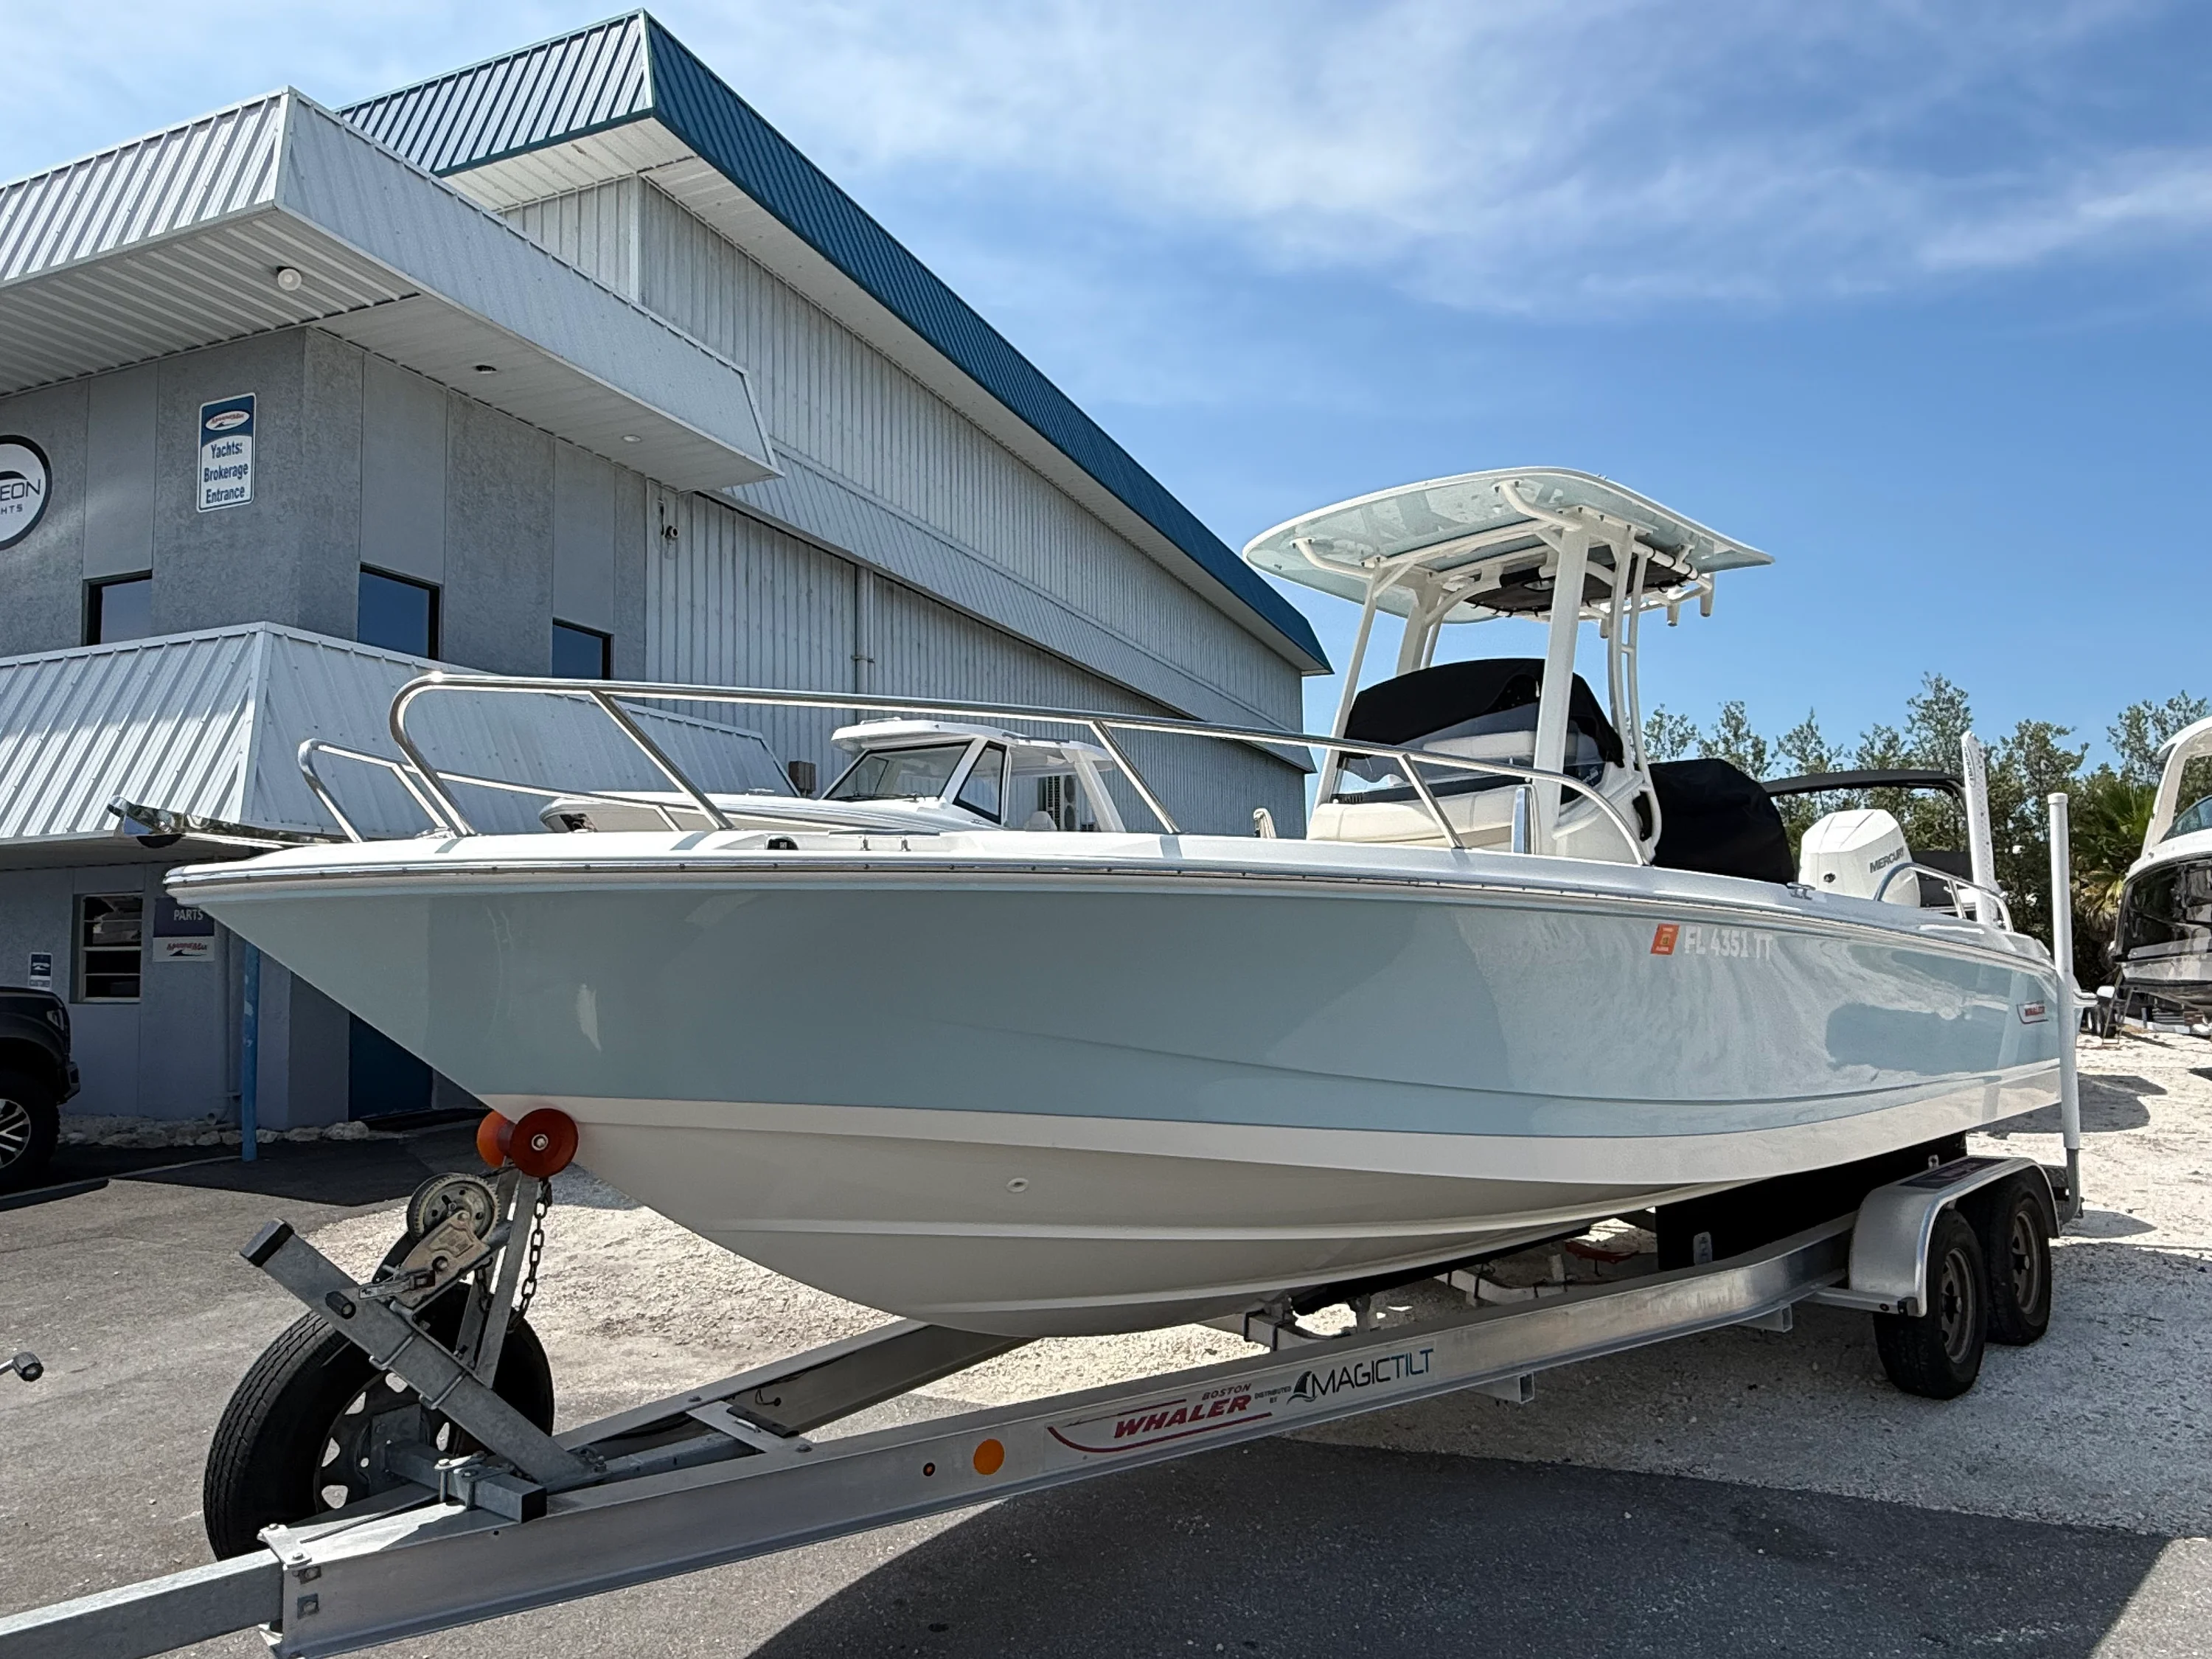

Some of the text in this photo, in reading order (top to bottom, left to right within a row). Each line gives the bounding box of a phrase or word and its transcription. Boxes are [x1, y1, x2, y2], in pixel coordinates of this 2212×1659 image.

[211, 440, 243, 459] Yachts:
[204, 463, 248, 482] Brokerage
[206, 486, 245, 504] Entrance
[1870, 846, 1905, 874] MERCURY
[173, 908, 204, 921] PARTS
[1684, 925, 1706, 955] FL
[1311, 1348, 1434, 1398] MAGICTILT
[1202, 1383, 1252, 1401] BOSTON
[1114, 1394, 1252, 1439] WHALER
